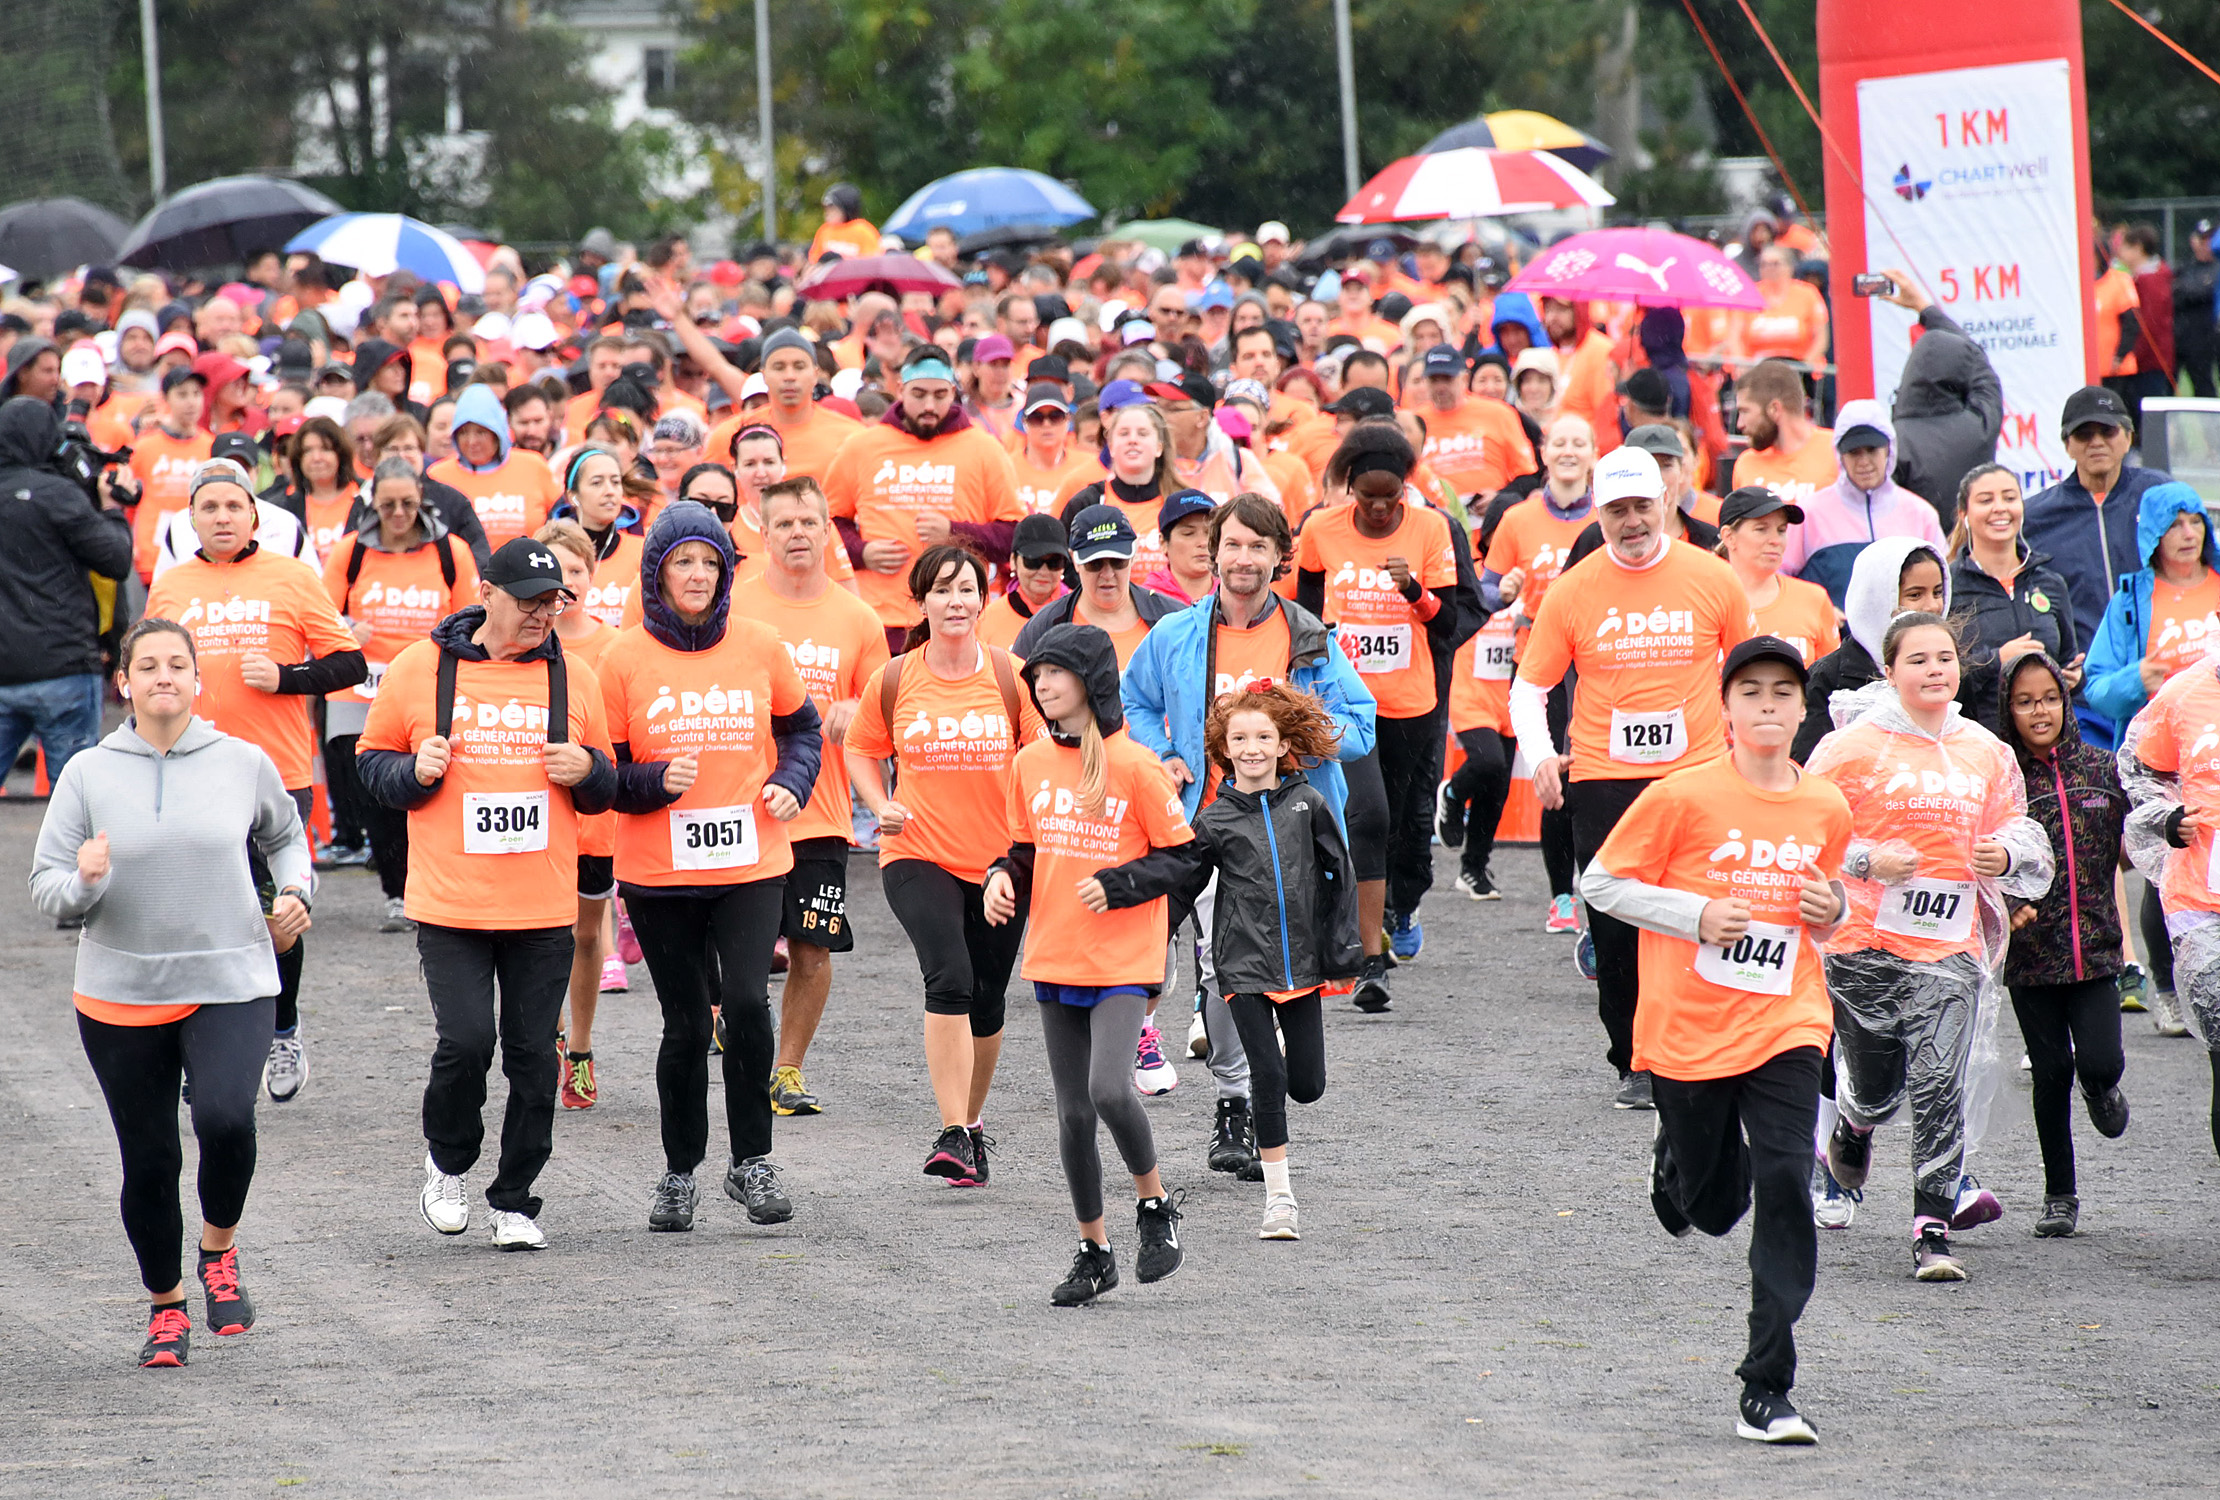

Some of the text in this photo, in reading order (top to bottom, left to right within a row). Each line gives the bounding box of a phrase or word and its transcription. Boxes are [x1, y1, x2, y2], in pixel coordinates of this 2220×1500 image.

[1936, 108, 2009, 148] 1 KM
[1940, 263, 2020, 303] 5 KM
[1963, 317, 2035, 333] BANQUE
[1981, 333, 2057, 350] ATIONALE
[1359, 636, 1399, 656] 345
[1597, 634, 1694, 652] des GÉNÉRATIONS
[1616, 648, 1694, 660] contre le cancer
[648, 715, 755, 734] des GÉNÉRATIONS
[670, 730, 755, 743] contre le cancer
[1622, 723, 1673, 746] 1287
[465, 744, 499, 754] contre
[502, 744, 512, 755] le
[904, 739, 1008, 753] des GÉNÉRATIONS
[925, 753, 959, 763] contre
[963, 752, 973, 762] le
[1885, 799, 1905, 811] des
[477, 805, 539, 832] 3304
[1907, 811, 1940, 821] contre
[1944, 812, 1952, 822] le
[686, 819, 742, 848] 3057
[1041, 815, 1120, 839] GÉNÉRATIONS
[1042, 832, 1118, 852] contre le cancer
[1707, 868, 1728, 882] des
[819, 884, 842, 899] LES
[1730, 888, 1769, 900] contre
[1773, 888, 1782, 901] le
[811, 897, 845, 915] MILLS
[1902, 889, 1961, 920] 1047
[803, 910, 842, 935] 19 6
